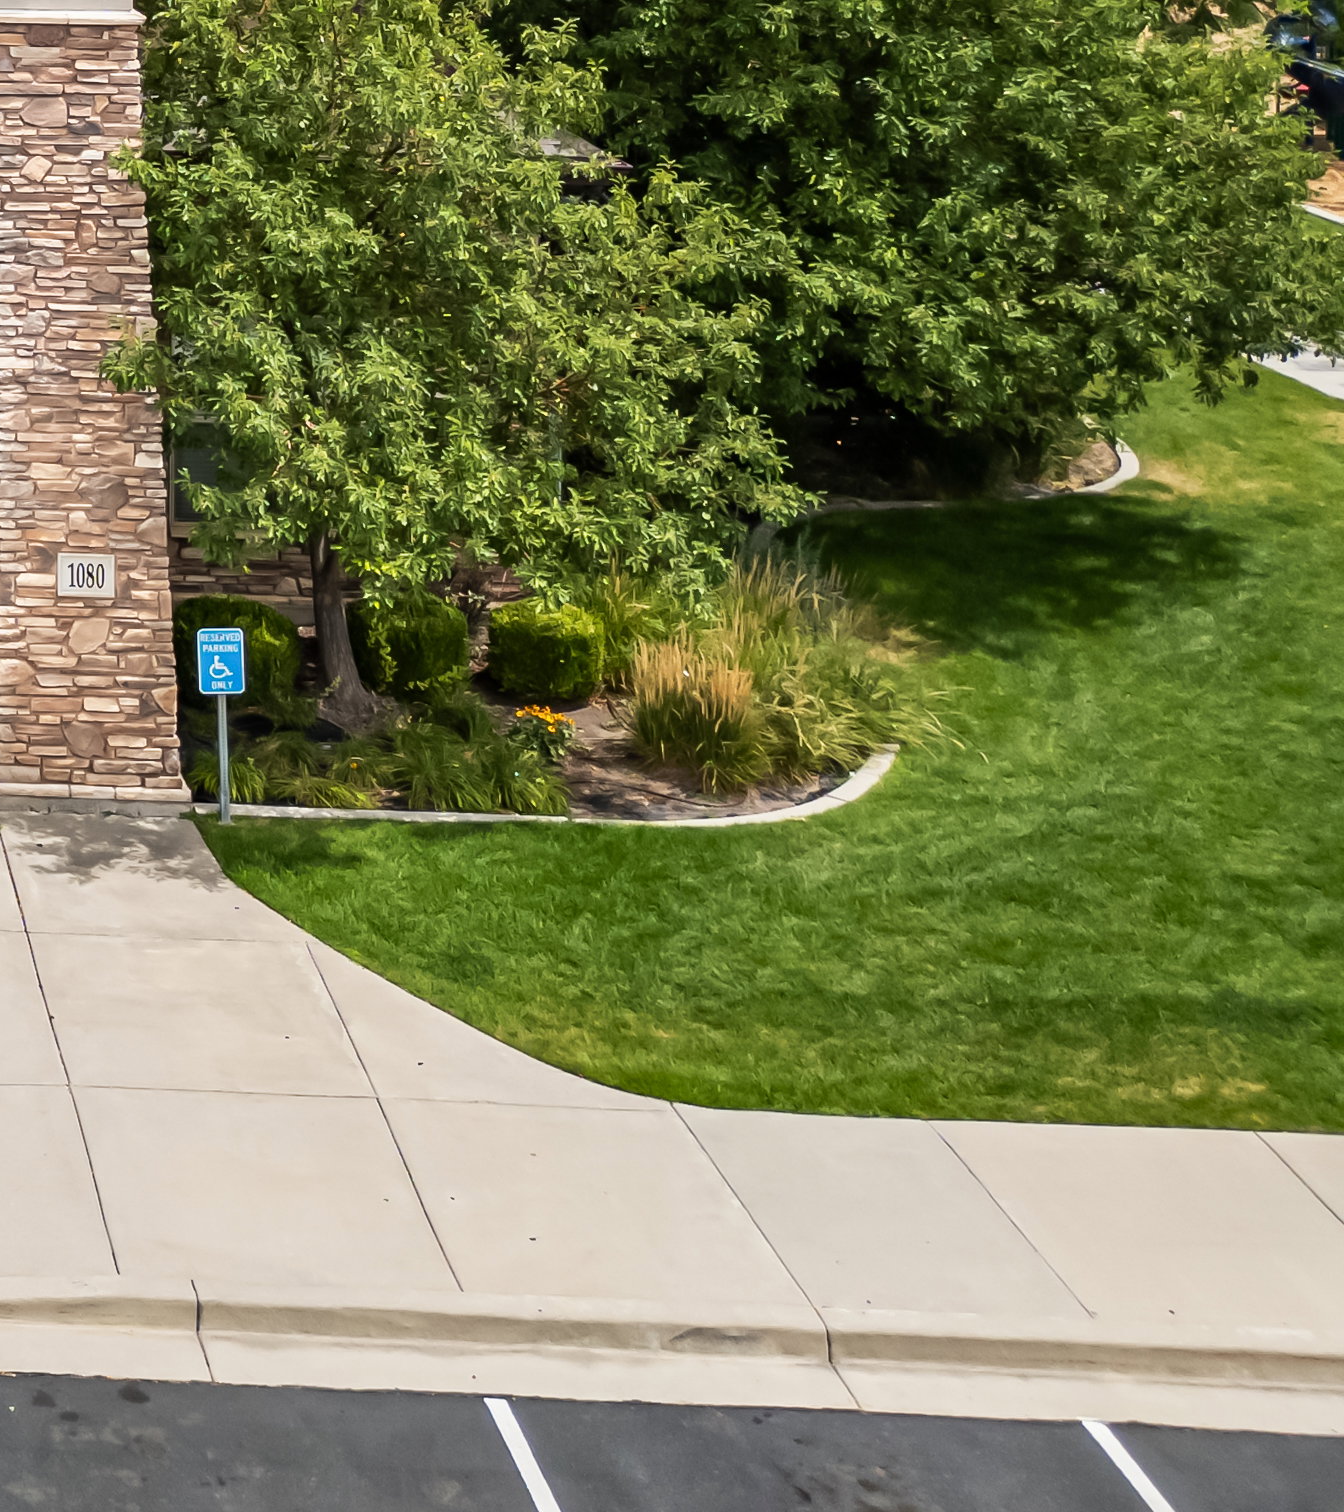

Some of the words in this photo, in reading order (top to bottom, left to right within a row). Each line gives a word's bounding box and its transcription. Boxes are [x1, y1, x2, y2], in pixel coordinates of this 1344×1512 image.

[67, 562, 105, 589] 1080
[200, 633, 240, 642] RESERVED
[202, 644, 239, 653] PARKING
[211, 681, 234, 690] ONLY
